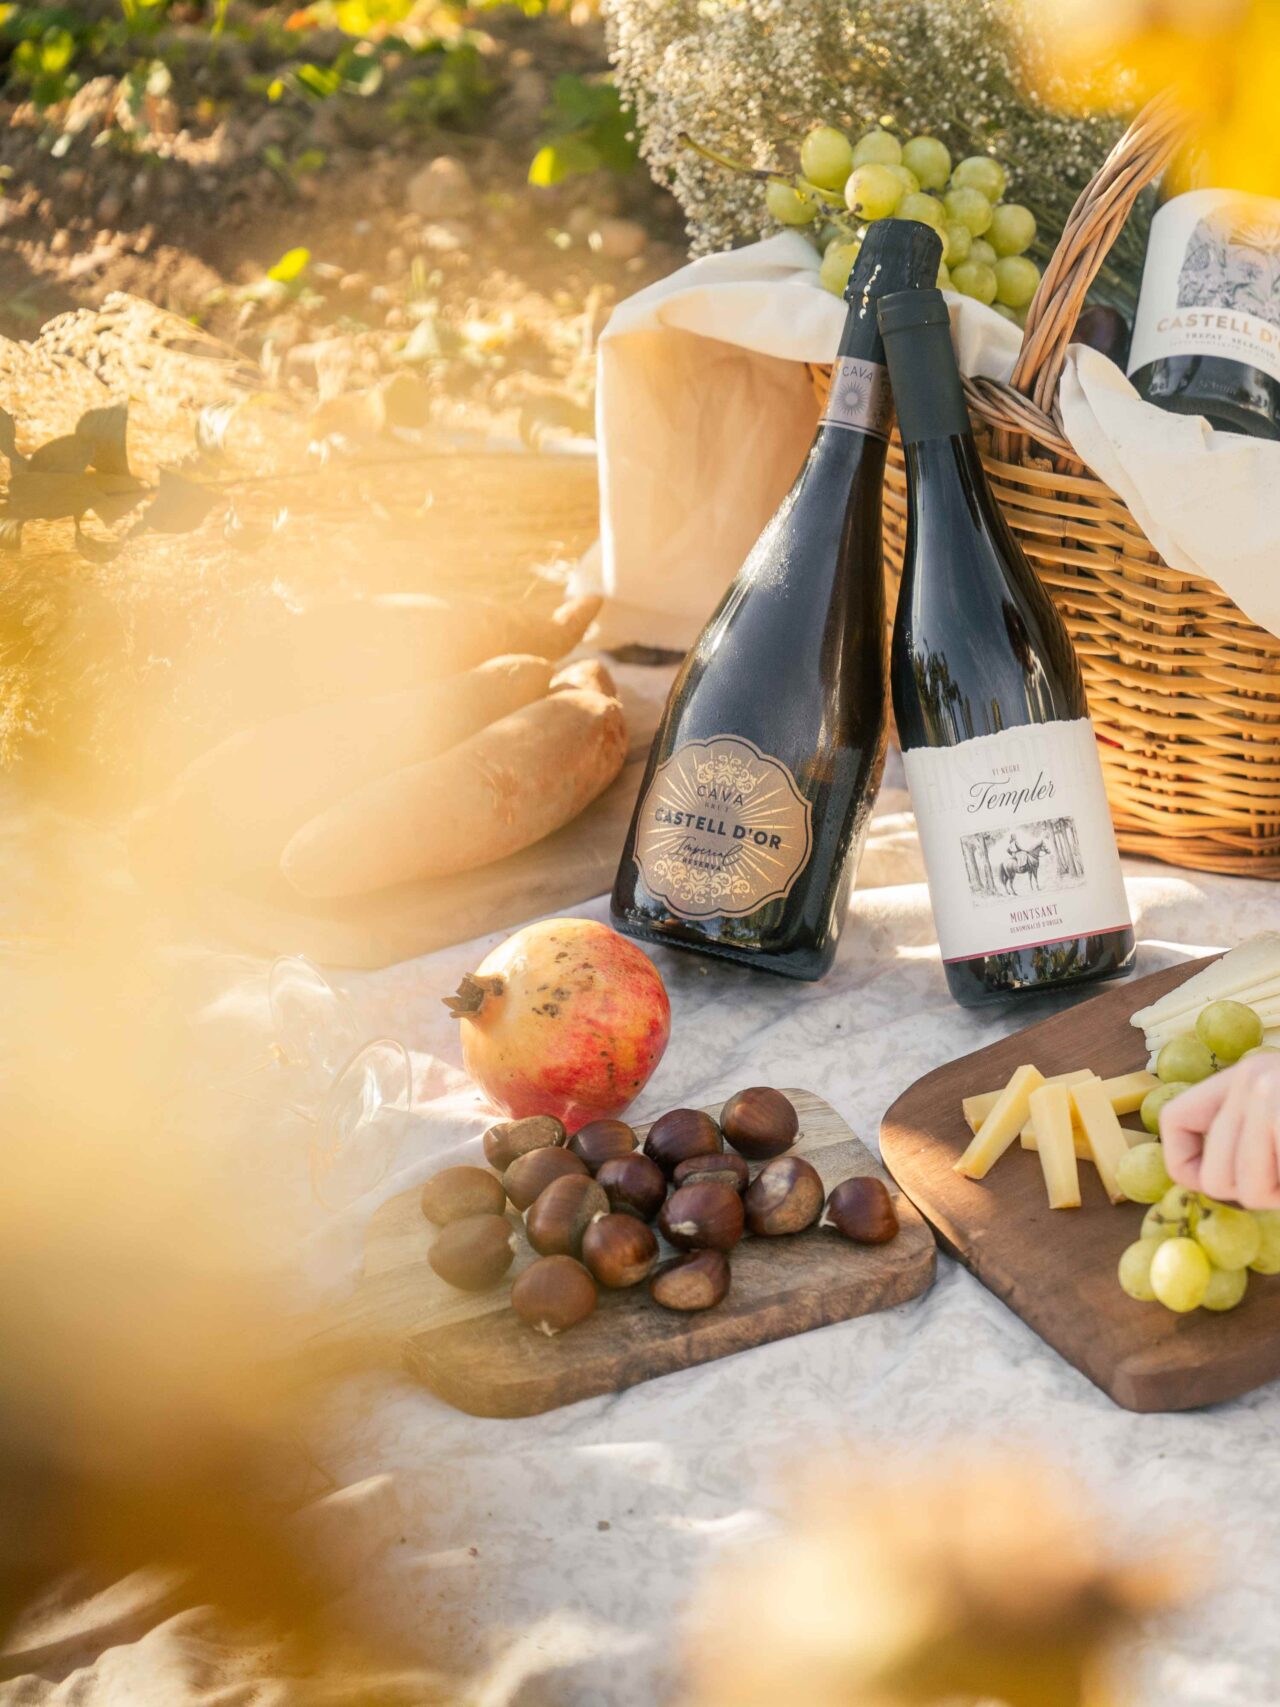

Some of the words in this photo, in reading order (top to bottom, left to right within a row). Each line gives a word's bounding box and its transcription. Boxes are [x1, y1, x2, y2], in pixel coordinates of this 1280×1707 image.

[1157, 313, 1253, 336] CASTELL
[842, 366, 873, 382] CAVA
[696, 785, 744, 806] CAVA
[966, 771, 1056, 814] Templer
[704, 801, 730, 814] BRUT
[655, 807, 727, 836] CASTELL
[732, 824, 782, 850] D'OR
[667, 836, 744, 867] Imperial
[682, 857, 722, 871] RESERVA
[1009, 903, 1059, 923] MONTSANT
